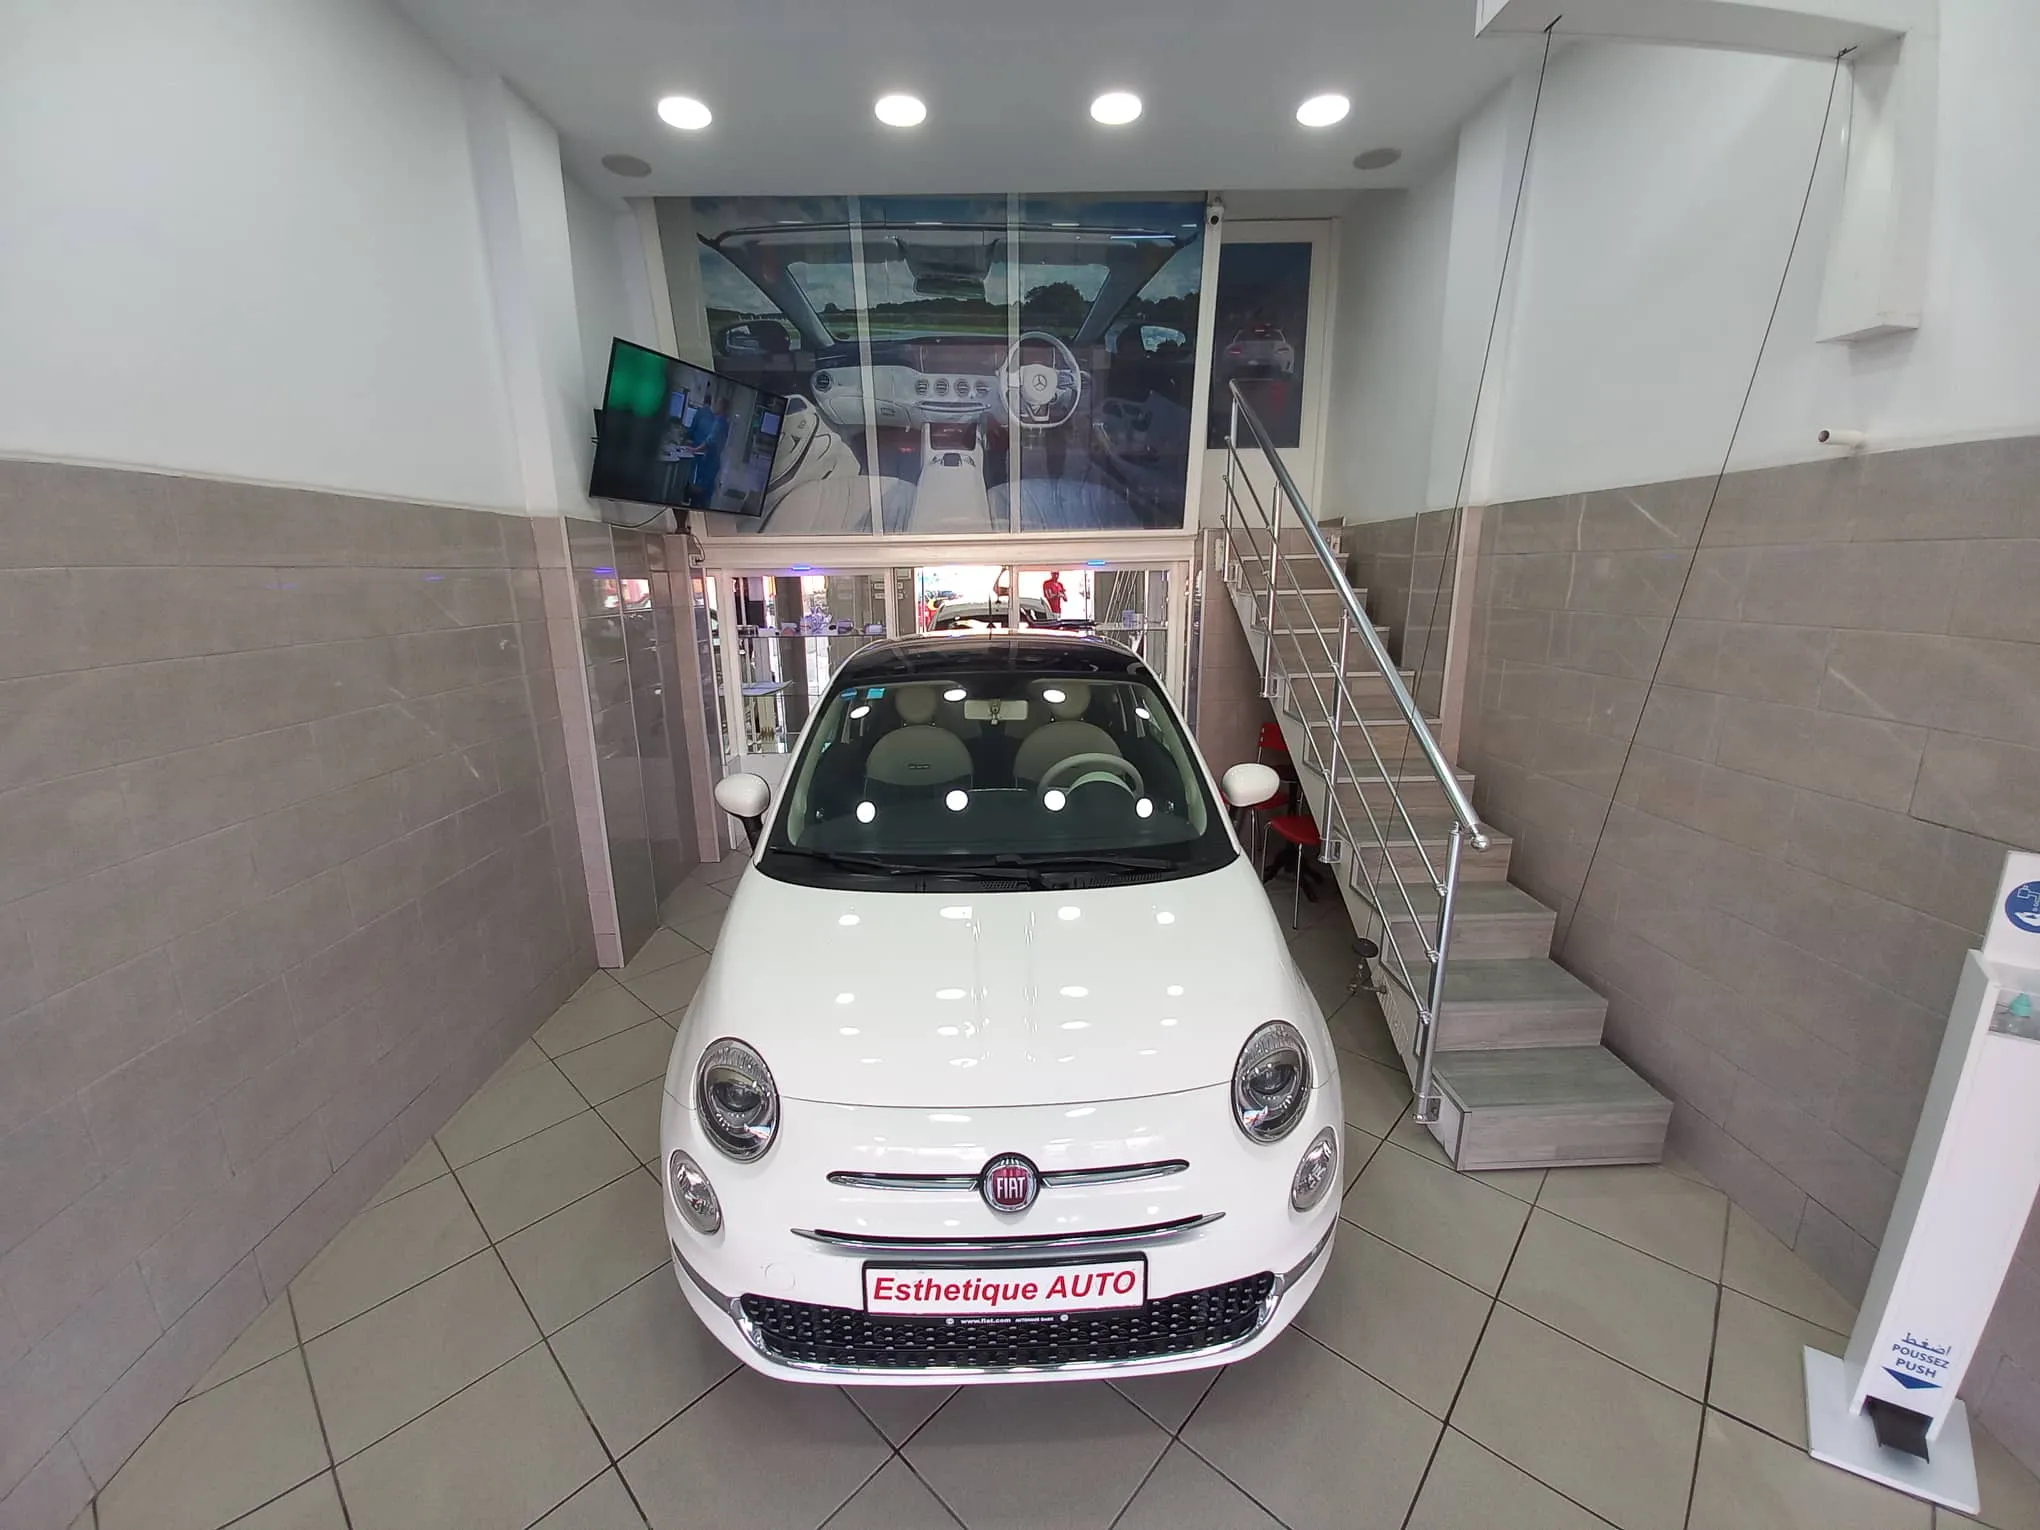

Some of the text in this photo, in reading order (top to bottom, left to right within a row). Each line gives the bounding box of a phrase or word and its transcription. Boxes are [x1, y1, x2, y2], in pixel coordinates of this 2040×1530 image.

[996, 1176, 1026, 1199] FIAT
[873, 1270, 1136, 1306] Esthetique AUTO
[1892, 1343, 1950, 1369] POUSSEZ
[1901, 1331, 1952, 1356] اضغط
[1896, 1357, 1937, 1378] PUSH
